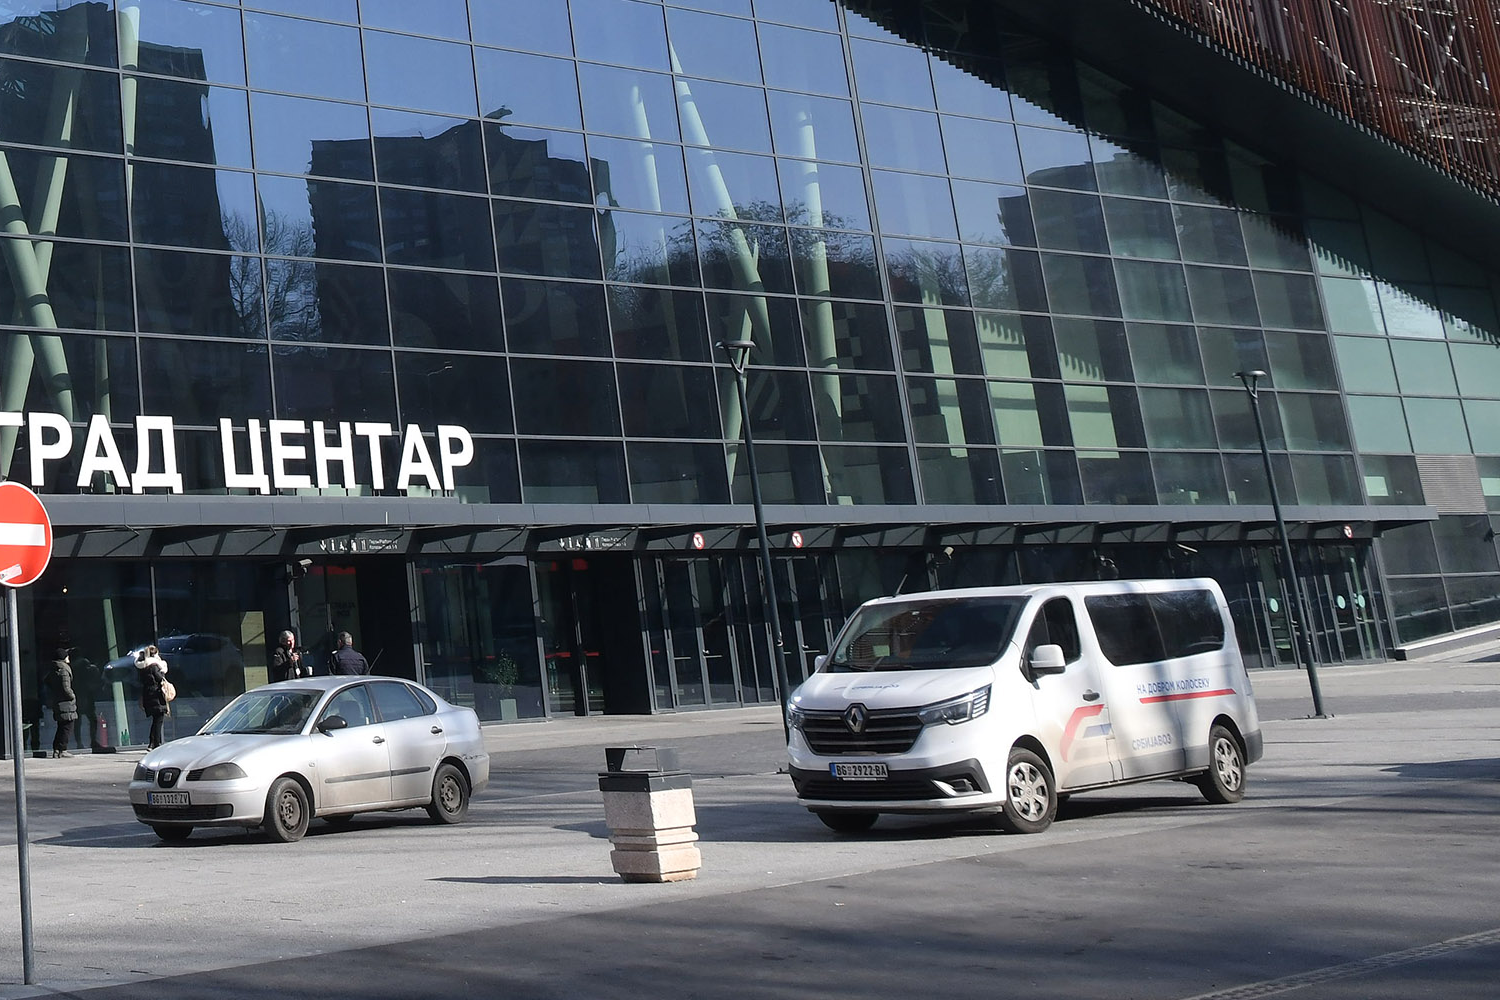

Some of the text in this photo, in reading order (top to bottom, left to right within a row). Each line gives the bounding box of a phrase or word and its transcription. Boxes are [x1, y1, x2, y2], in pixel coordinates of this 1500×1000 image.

[219, 417, 474, 495] ЦЕНТАР
[1148, 681, 1175, 695] ДОБРОМ
[1176, 678, 1210, 691] КОЛОСЕКУ
[1132, 734, 1171, 750] СРБИЈАВОЗ
[836, 765, 886, 776] BG 2922-BA
